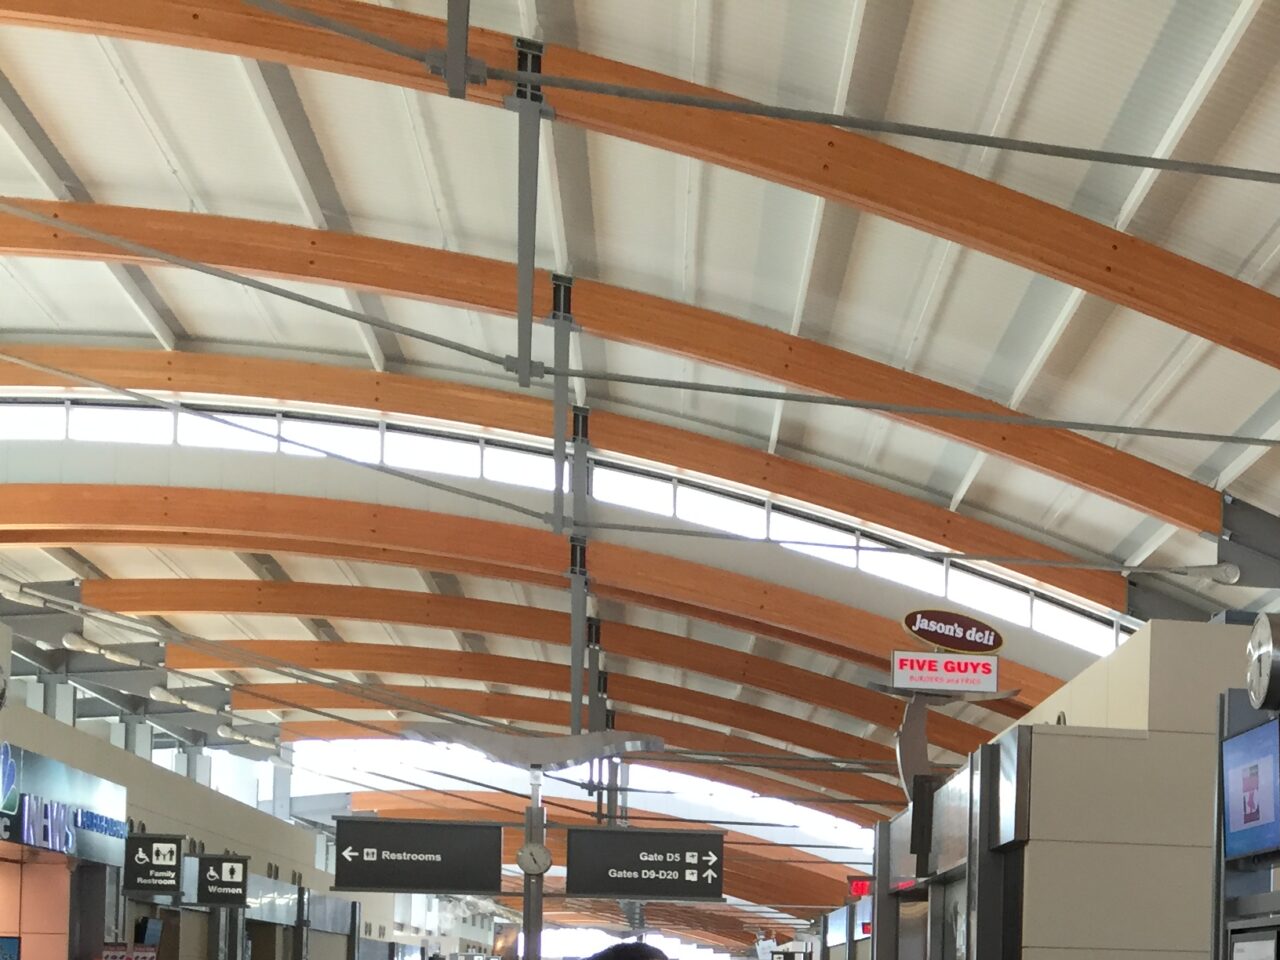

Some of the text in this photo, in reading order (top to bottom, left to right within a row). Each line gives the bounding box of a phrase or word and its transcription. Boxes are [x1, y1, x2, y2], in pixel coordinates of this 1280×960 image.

[965, 626, 995, 646] deli
[898, 658, 992, 675] FIVE GUYS
[19, 793, 77, 855] NEWS
[381, 850, 442, 863] Restrooms
[639, 851, 681, 863] Gate D5
[136, 877, 176, 885] Restroom
[149, 869, 176, 880] Family
[608, 868, 679, 881] Gates D9-D20
[208, 885, 243, 894] Women
